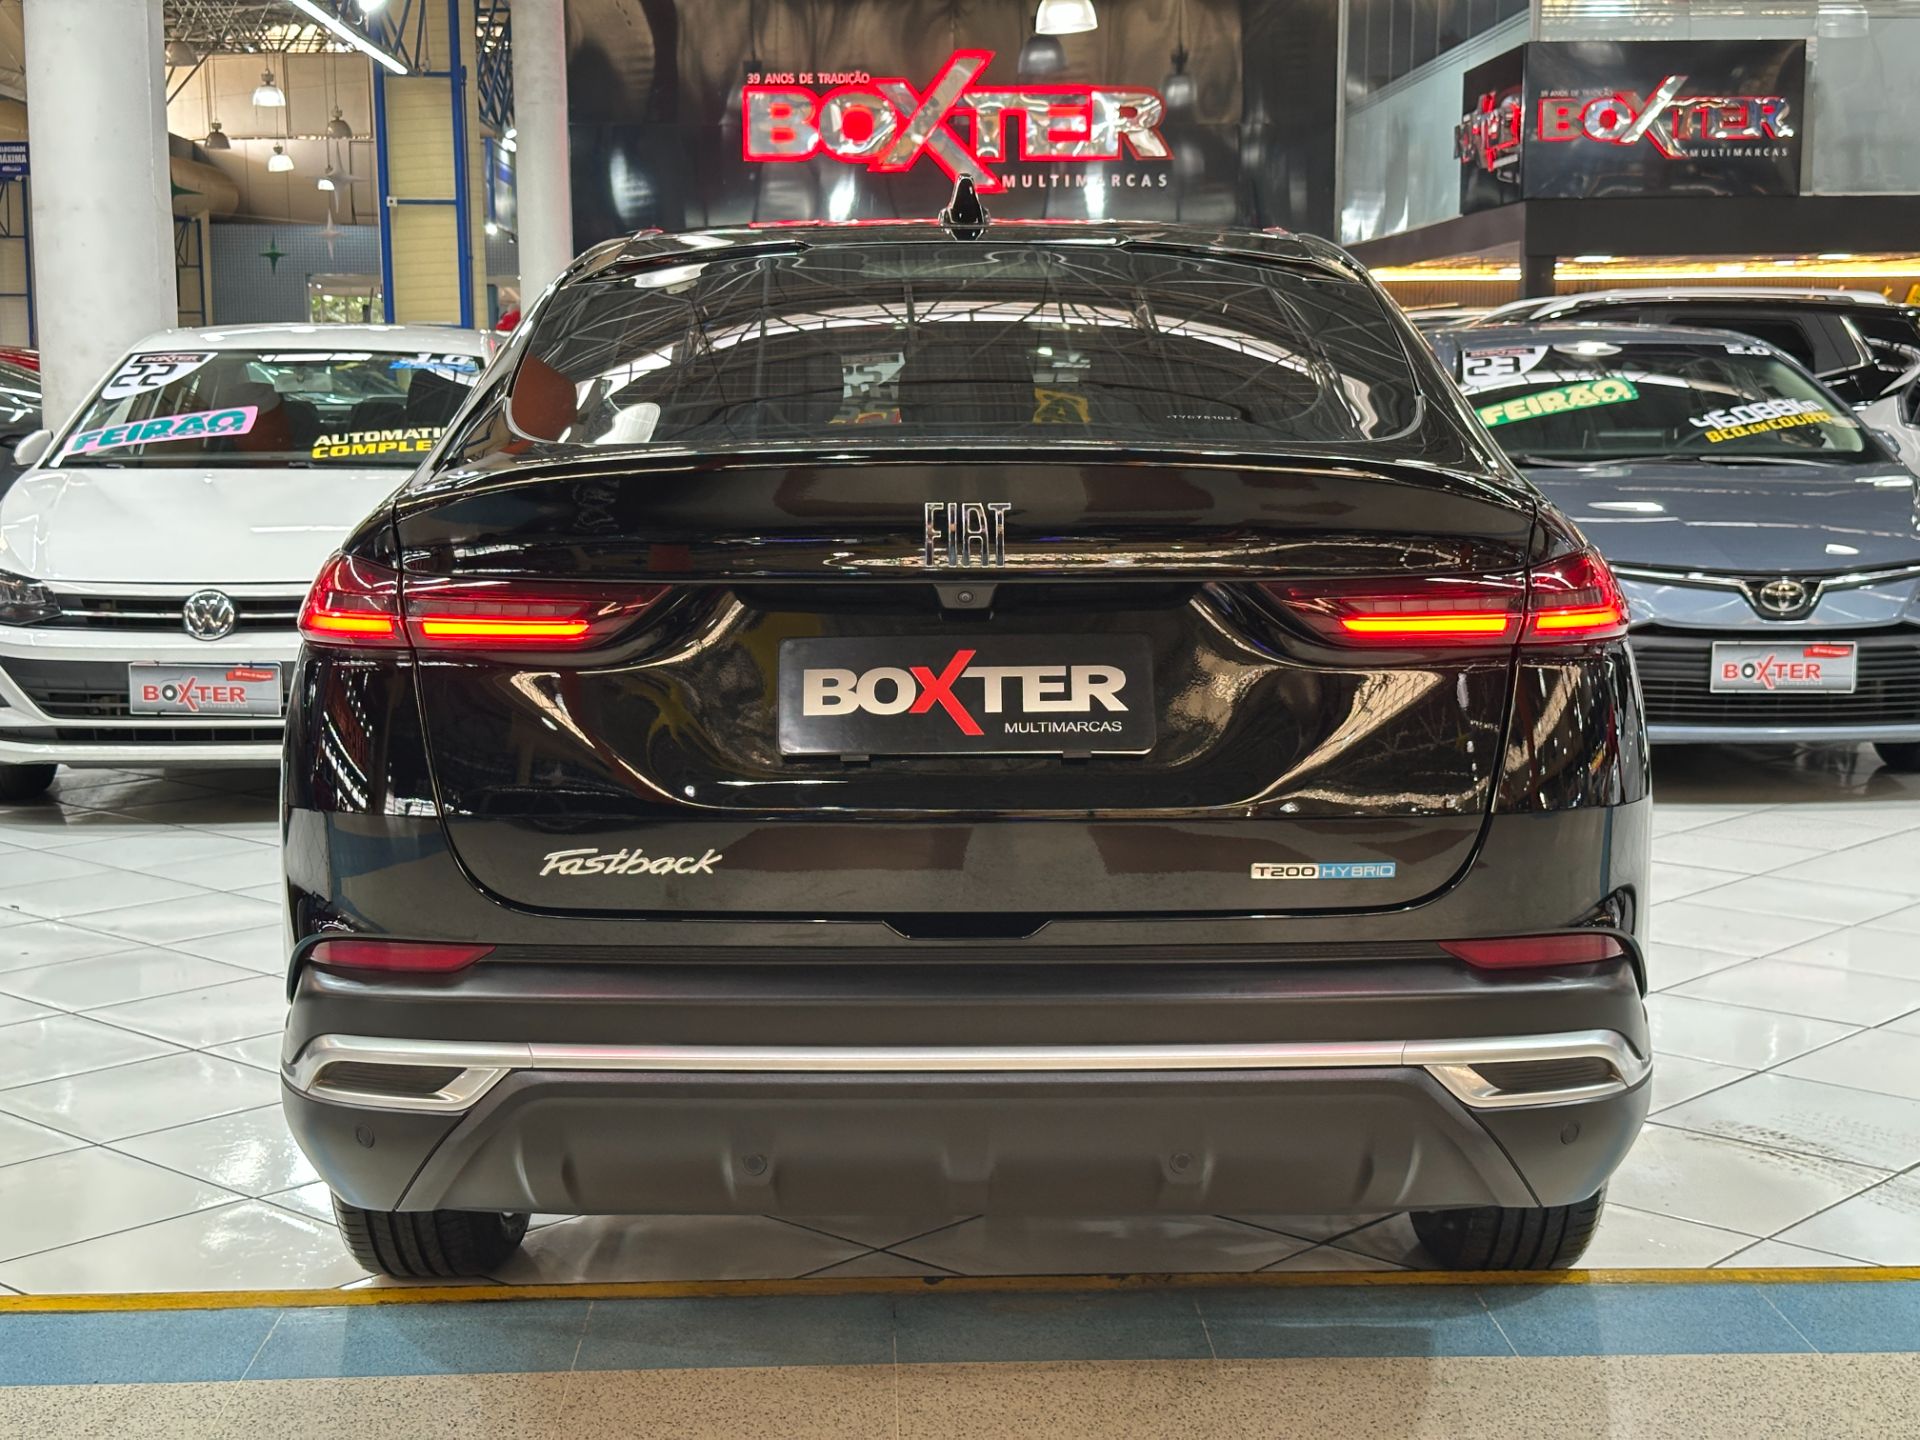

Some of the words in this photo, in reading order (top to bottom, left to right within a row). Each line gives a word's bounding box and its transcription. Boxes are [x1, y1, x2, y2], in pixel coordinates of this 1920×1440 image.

[747, 72, 760, 84] 39
[765, 72, 795, 84] ANOS
[799, 73, 813, 84] DE
[817, 71, 870, 85] TRADIÇÃO
[743, 49, 1175, 193] BOXTER
[1538, 75, 1795, 159] BOXTER
[1689, 148, 1788, 157] MULTIMARCAS
[110, 364, 178, 387] 22
[1467, 357, 1521, 376] 23
[1480, 379, 1634, 425] FEIRÃO
[72, 410, 247, 451] FEIRÃO
[312, 440, 440, 459] COMPLE
[925, 502, 1012, 568] FIAT
[1722, 653, 1822, 690] BOXTER
[142, 676, 247, 711] BOXTER
[803, 649, 1129, 736] BOXTER
[1004, 721, 1123, 734] MULTIMARCAS
[539, 848, 723, 876] Fastback
[1254, 866, 1316, 877] T200
[1322, 865, 1394, 877] HYBRID
